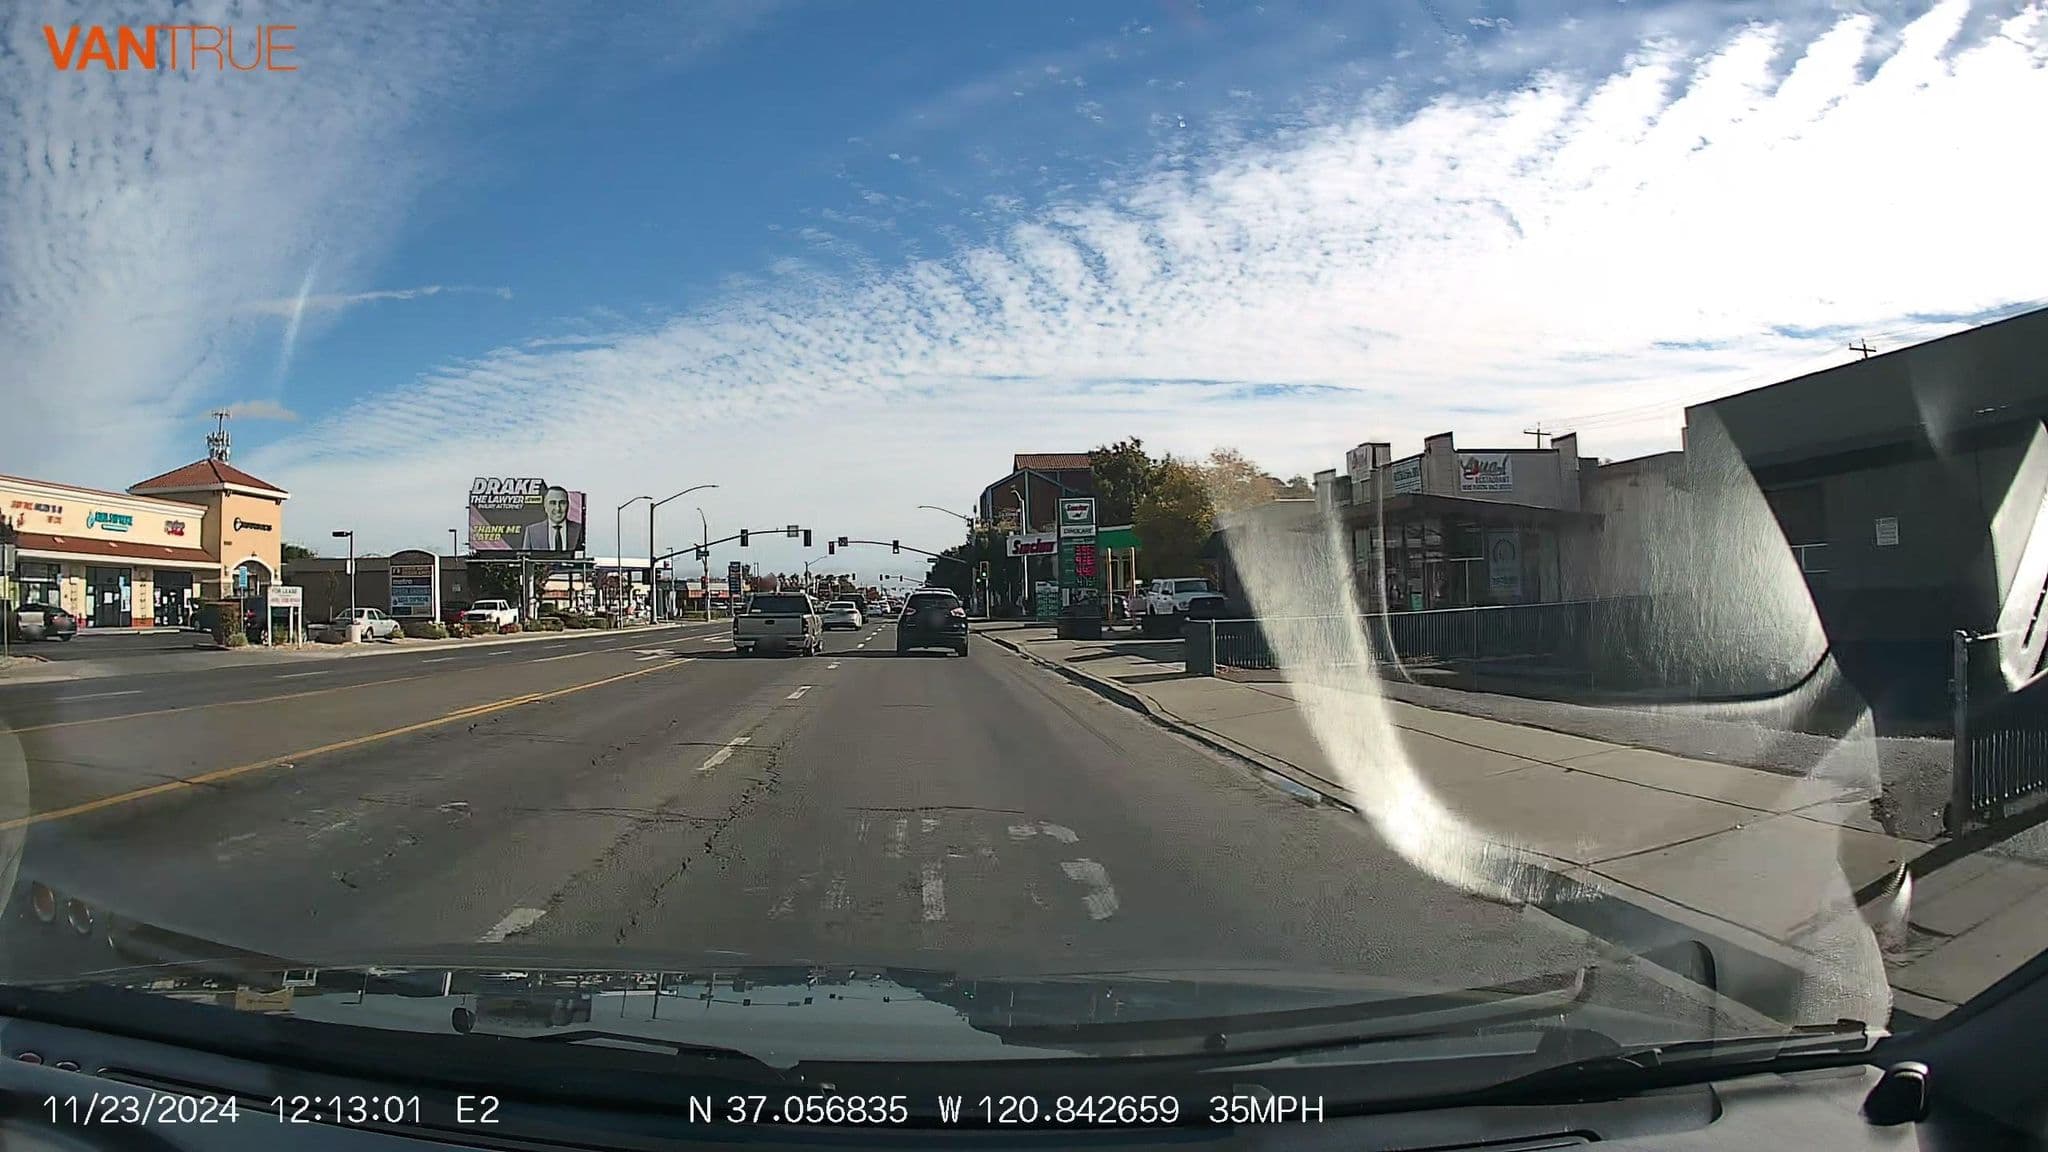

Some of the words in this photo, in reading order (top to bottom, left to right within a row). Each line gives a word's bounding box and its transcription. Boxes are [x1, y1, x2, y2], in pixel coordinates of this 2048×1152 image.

[472, 478, 542, 495] DRAKE
[470, 495, 487, 504] THE
[487, 495, 524, 504] LAWYER
[472, 525, 505, 534] THANK
[506, 525, 521, 534] ME
[1012, 538, 1055, 555] Sinclair
